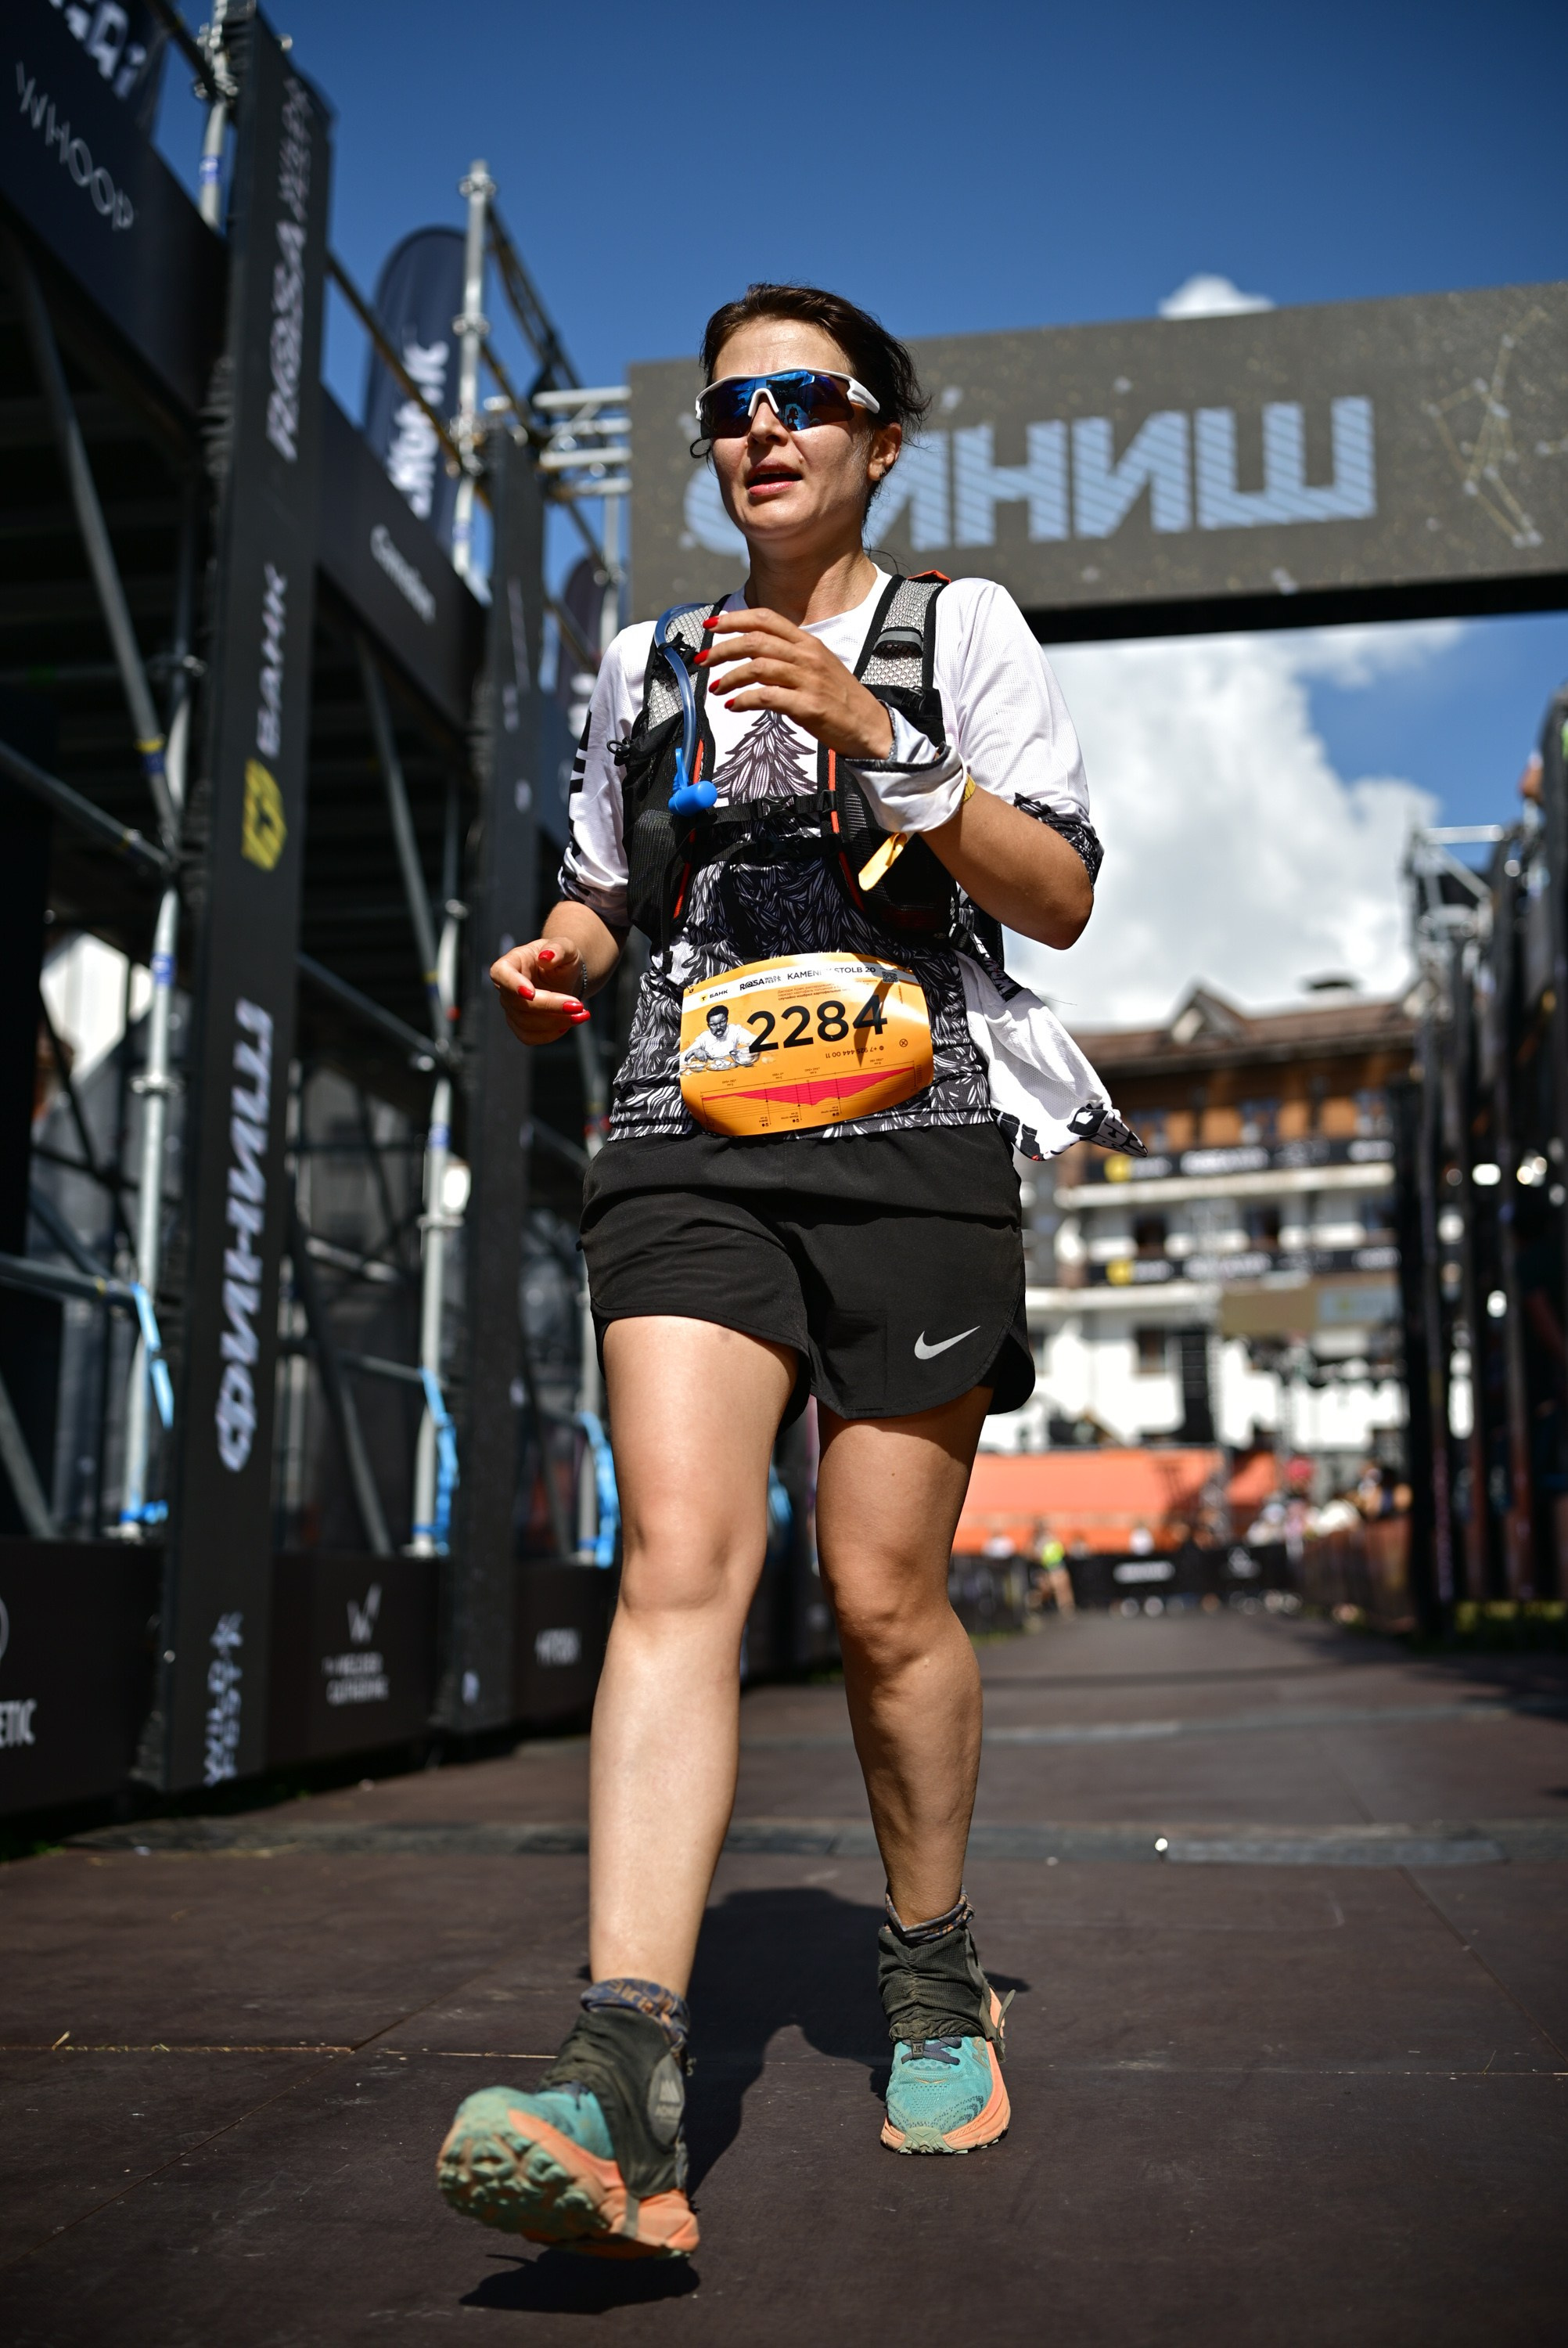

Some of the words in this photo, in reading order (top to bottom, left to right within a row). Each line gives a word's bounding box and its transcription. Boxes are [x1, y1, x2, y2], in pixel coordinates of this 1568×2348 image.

[16, 60, 135, 231] WHOOP
[739, 978, 765, 991] ROSA
[787, 968, 832, 980] KAMEN
[709, 989, 728, 999] БАНК
[746, 994, 888, 1053] 2284
[215, 996, 274, 1472] ФИНИШ
